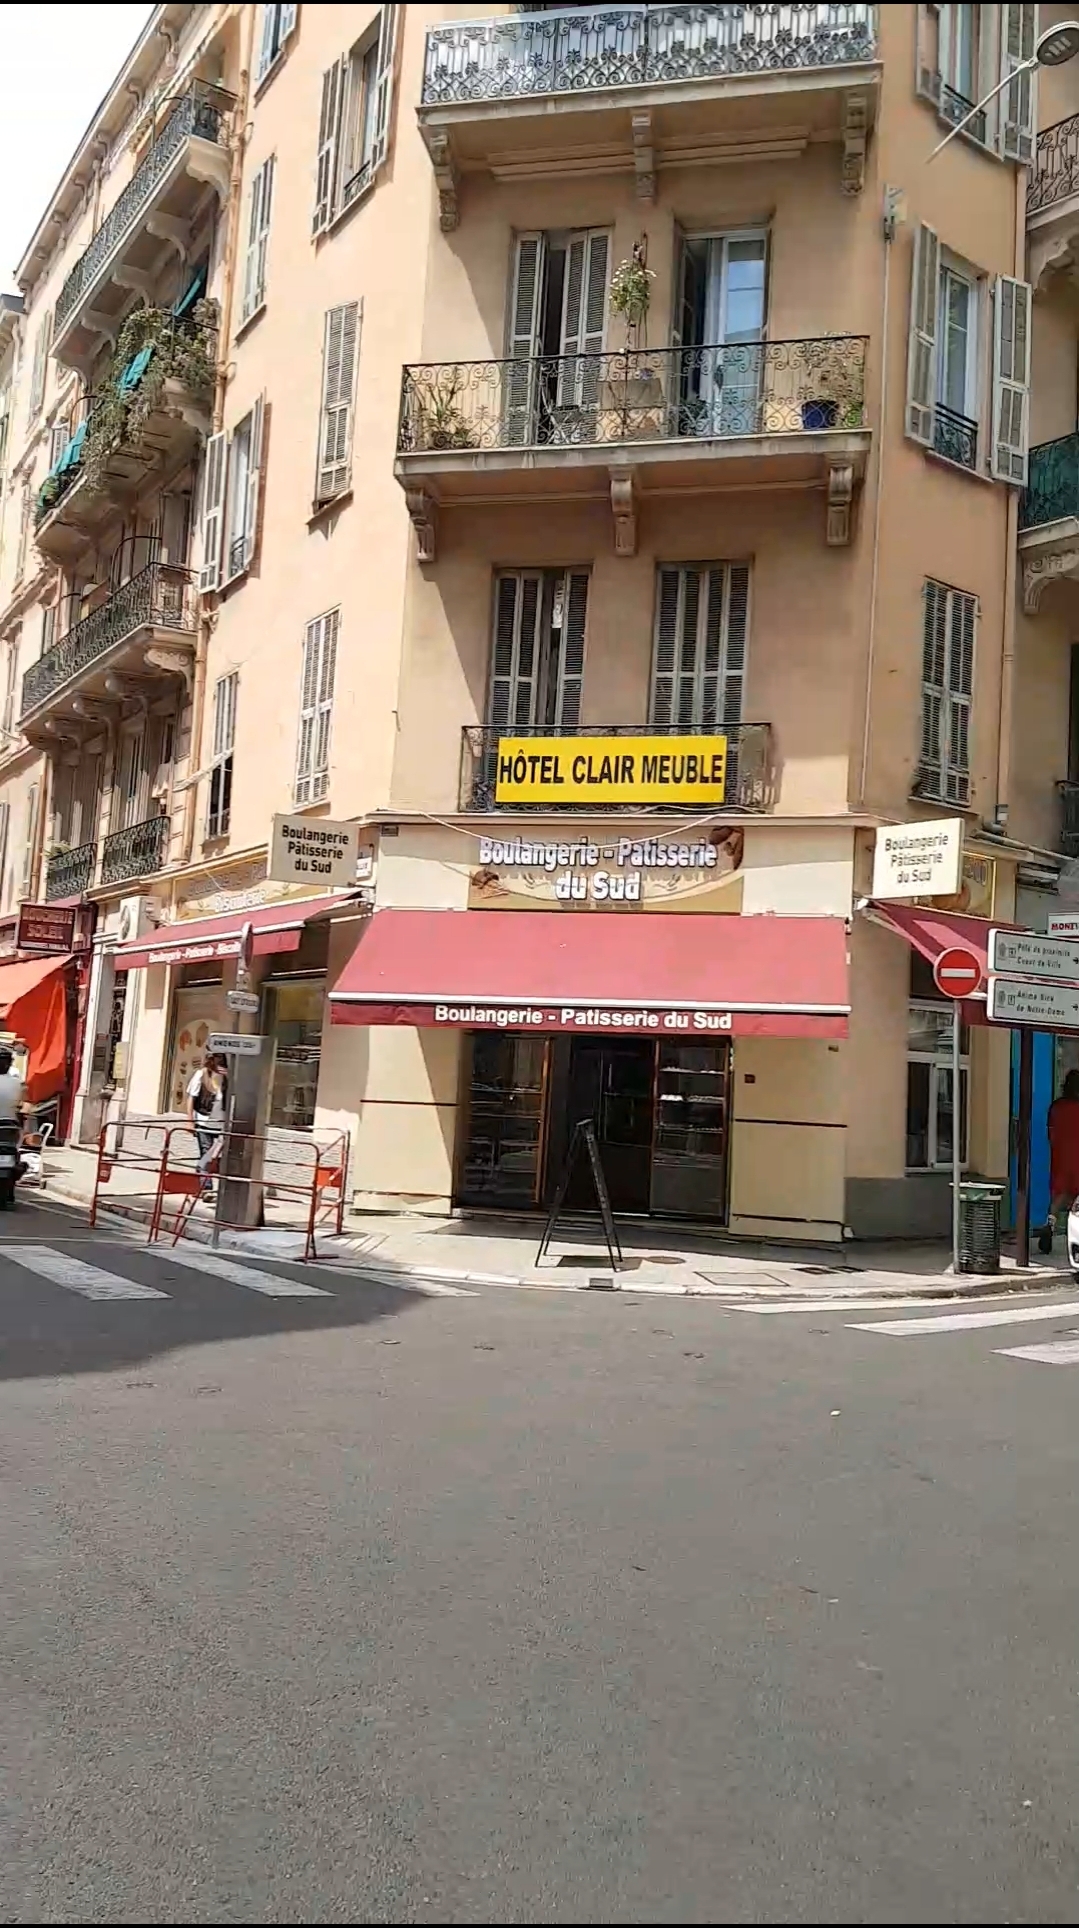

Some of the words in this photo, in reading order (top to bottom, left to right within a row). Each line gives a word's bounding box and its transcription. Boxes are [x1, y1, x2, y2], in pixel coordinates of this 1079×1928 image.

[499, 749, 564, 784] HÔTEL
[572, 754, 635, 784] CLAIR
[641, 754, 723, 784] MEUBLE
[282, 825, 349, 845] Boulangerie
[885, 832, 949, 851] Boulangerie
[287, 841, 343, 859] Pâtisserie
[478, 836, 598, 871] Boulangerie
[616, 837, 718, 868] Patisserie
[294, 858, 309, 871] du
[310, 859, 332, 873] Sud
[897, 870, 909, 883] du
[912, 868, 932, 882] Sud
[555, 870, 589, 900] du
[591, 871, 642, 901] Sud
[434, 1004, 543, 1026] Boulangerie
[560, 1009, 659, 1028] Patisserie
[664, 1011, 689, 1028] du
[693, 1012, 733, 1030] Sud
